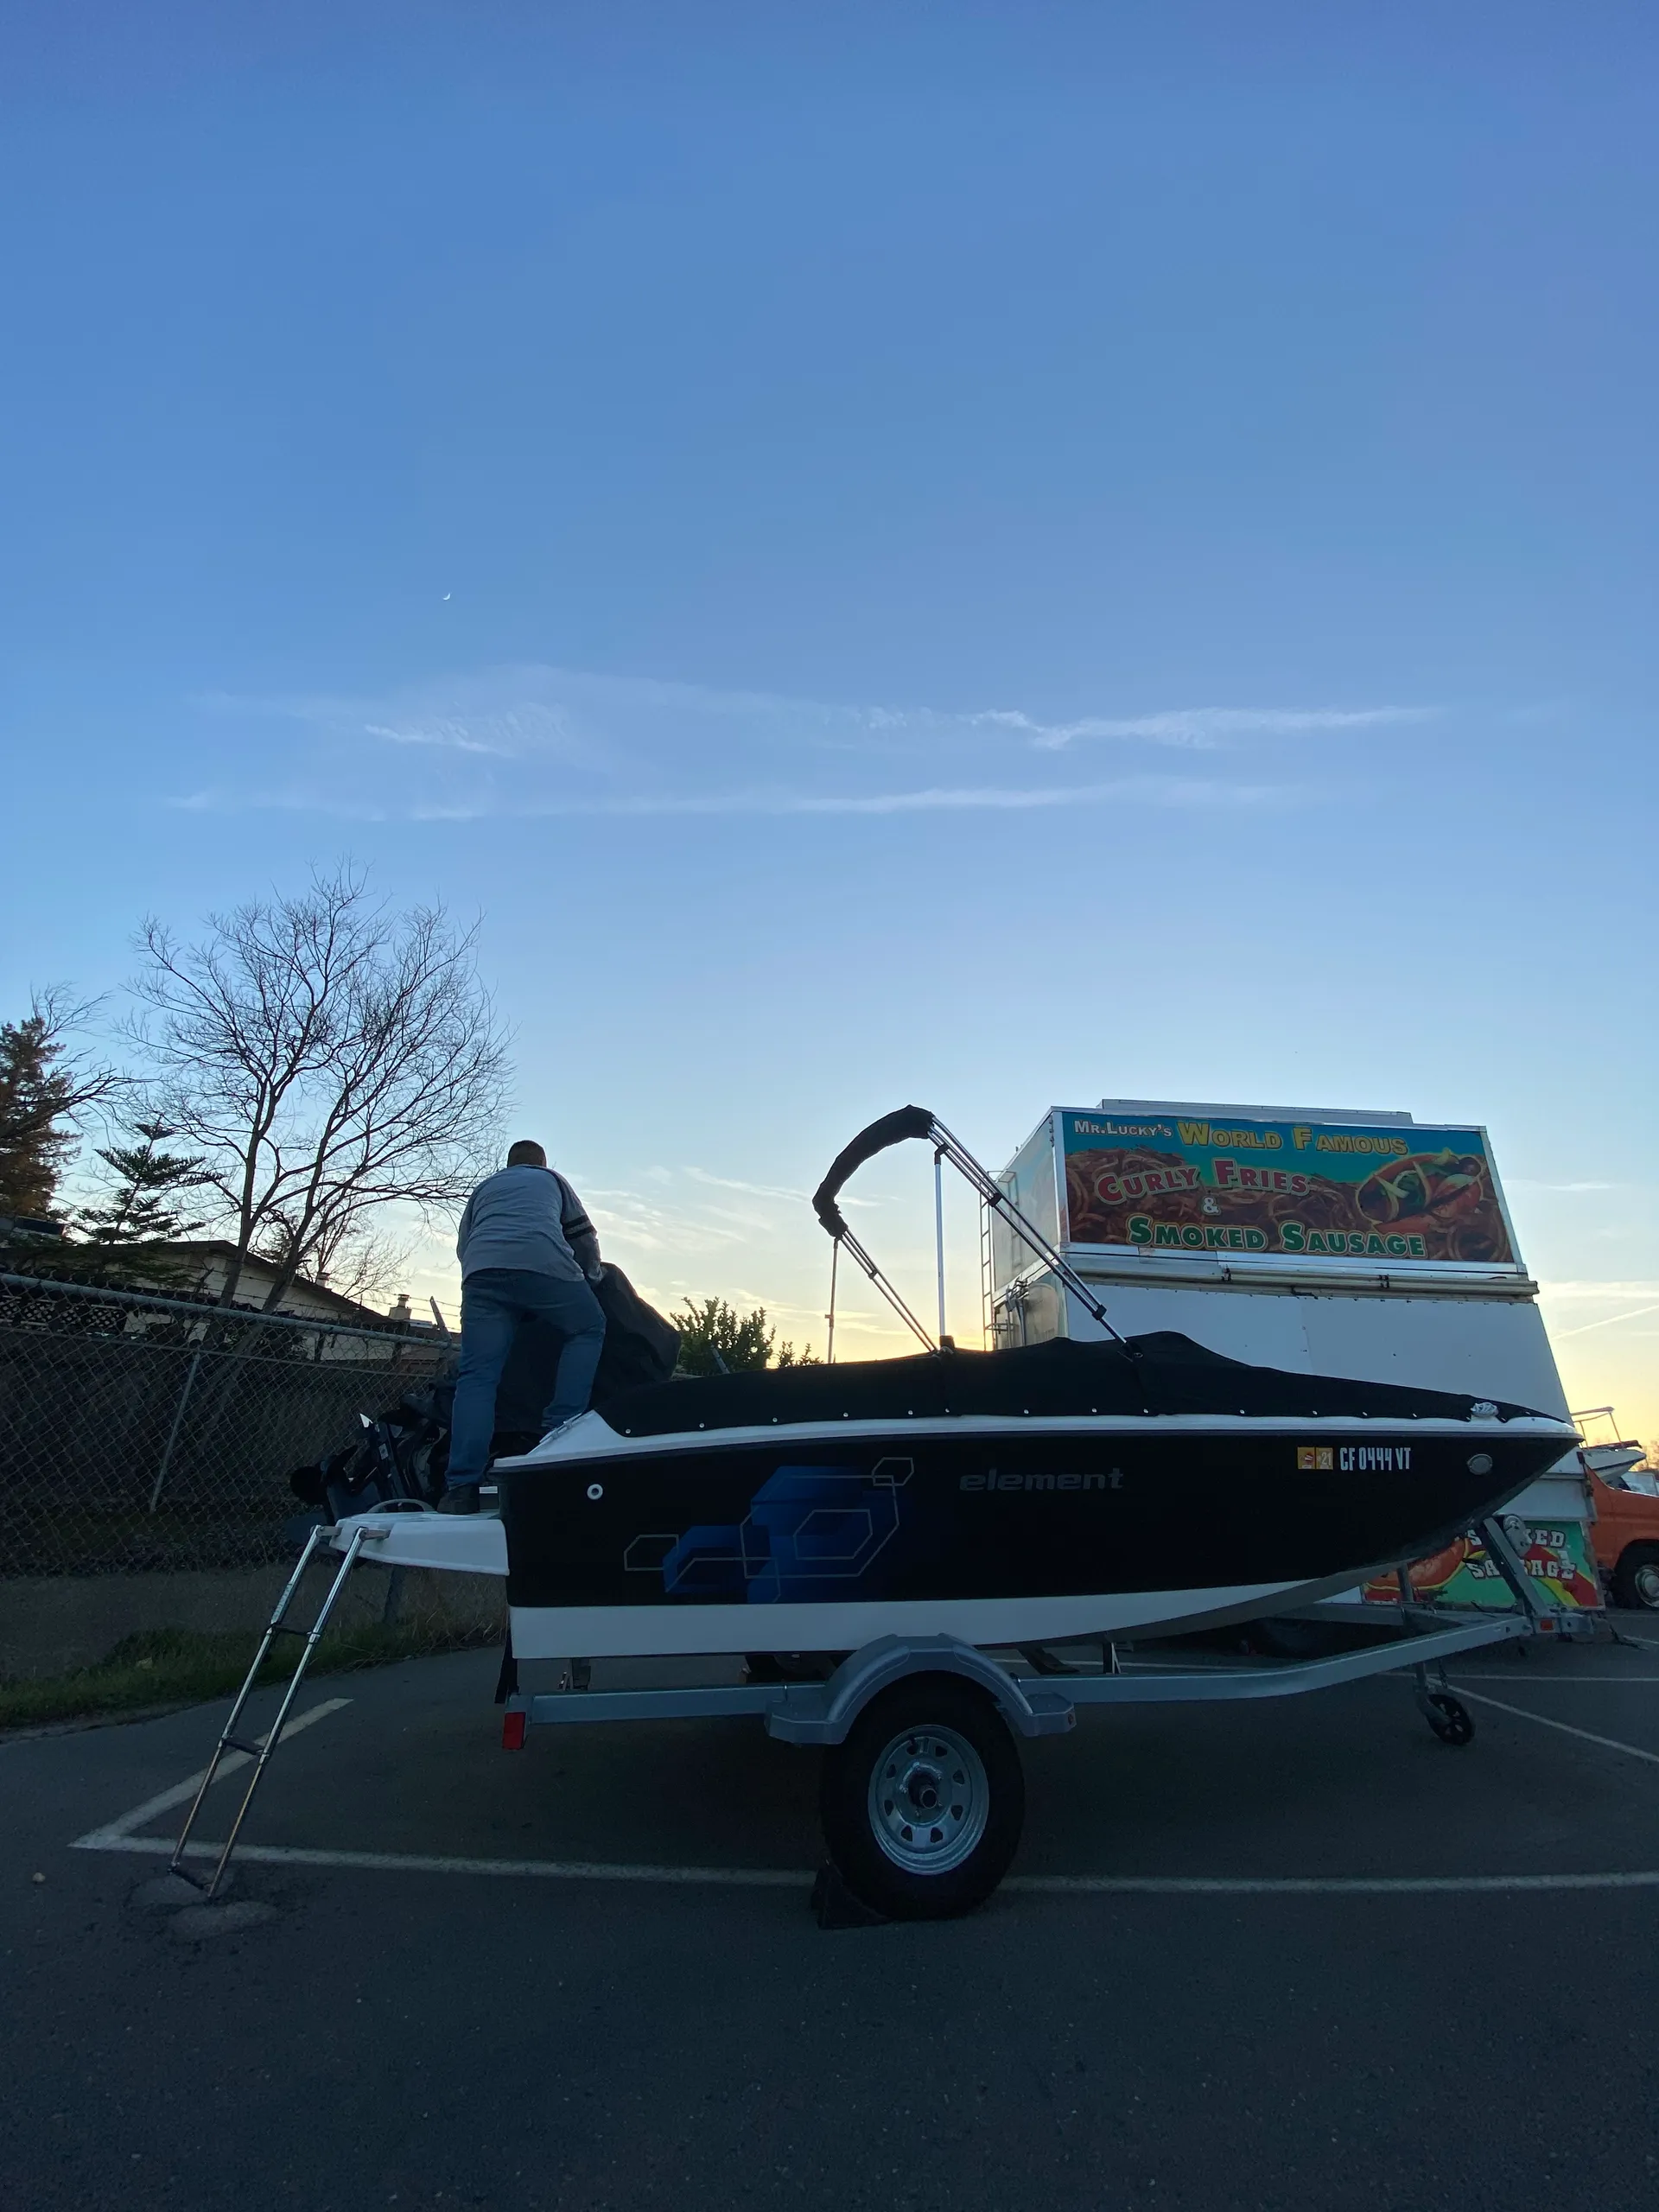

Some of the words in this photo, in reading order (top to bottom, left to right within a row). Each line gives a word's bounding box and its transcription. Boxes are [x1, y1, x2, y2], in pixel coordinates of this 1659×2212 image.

[1178, 1121, 1282, 1149] WORLD
[1293, 1127, 1408, 1155] FAMOUS
[1096, 1166, 1198, 1204] CURLY
[1212, 1159, 1310, 1195] FRIES
[1202, 1197, 1221, 1215] &
[1127, 1214, 1267, 1250] SMOKED
[1280, 1220, 1427, 1257] SAUSAGE
[1339, 1447, 1356, 1471] CF
[1358, 1447, 1392, 1471] 0444
[1395, 1447, 1411, 1470] VT
[959, 1466, 1124, 1491] element
[1466, 1528, 1565, 1548] SKED
[1465, 1558, 1575, 1580] SAAGE
